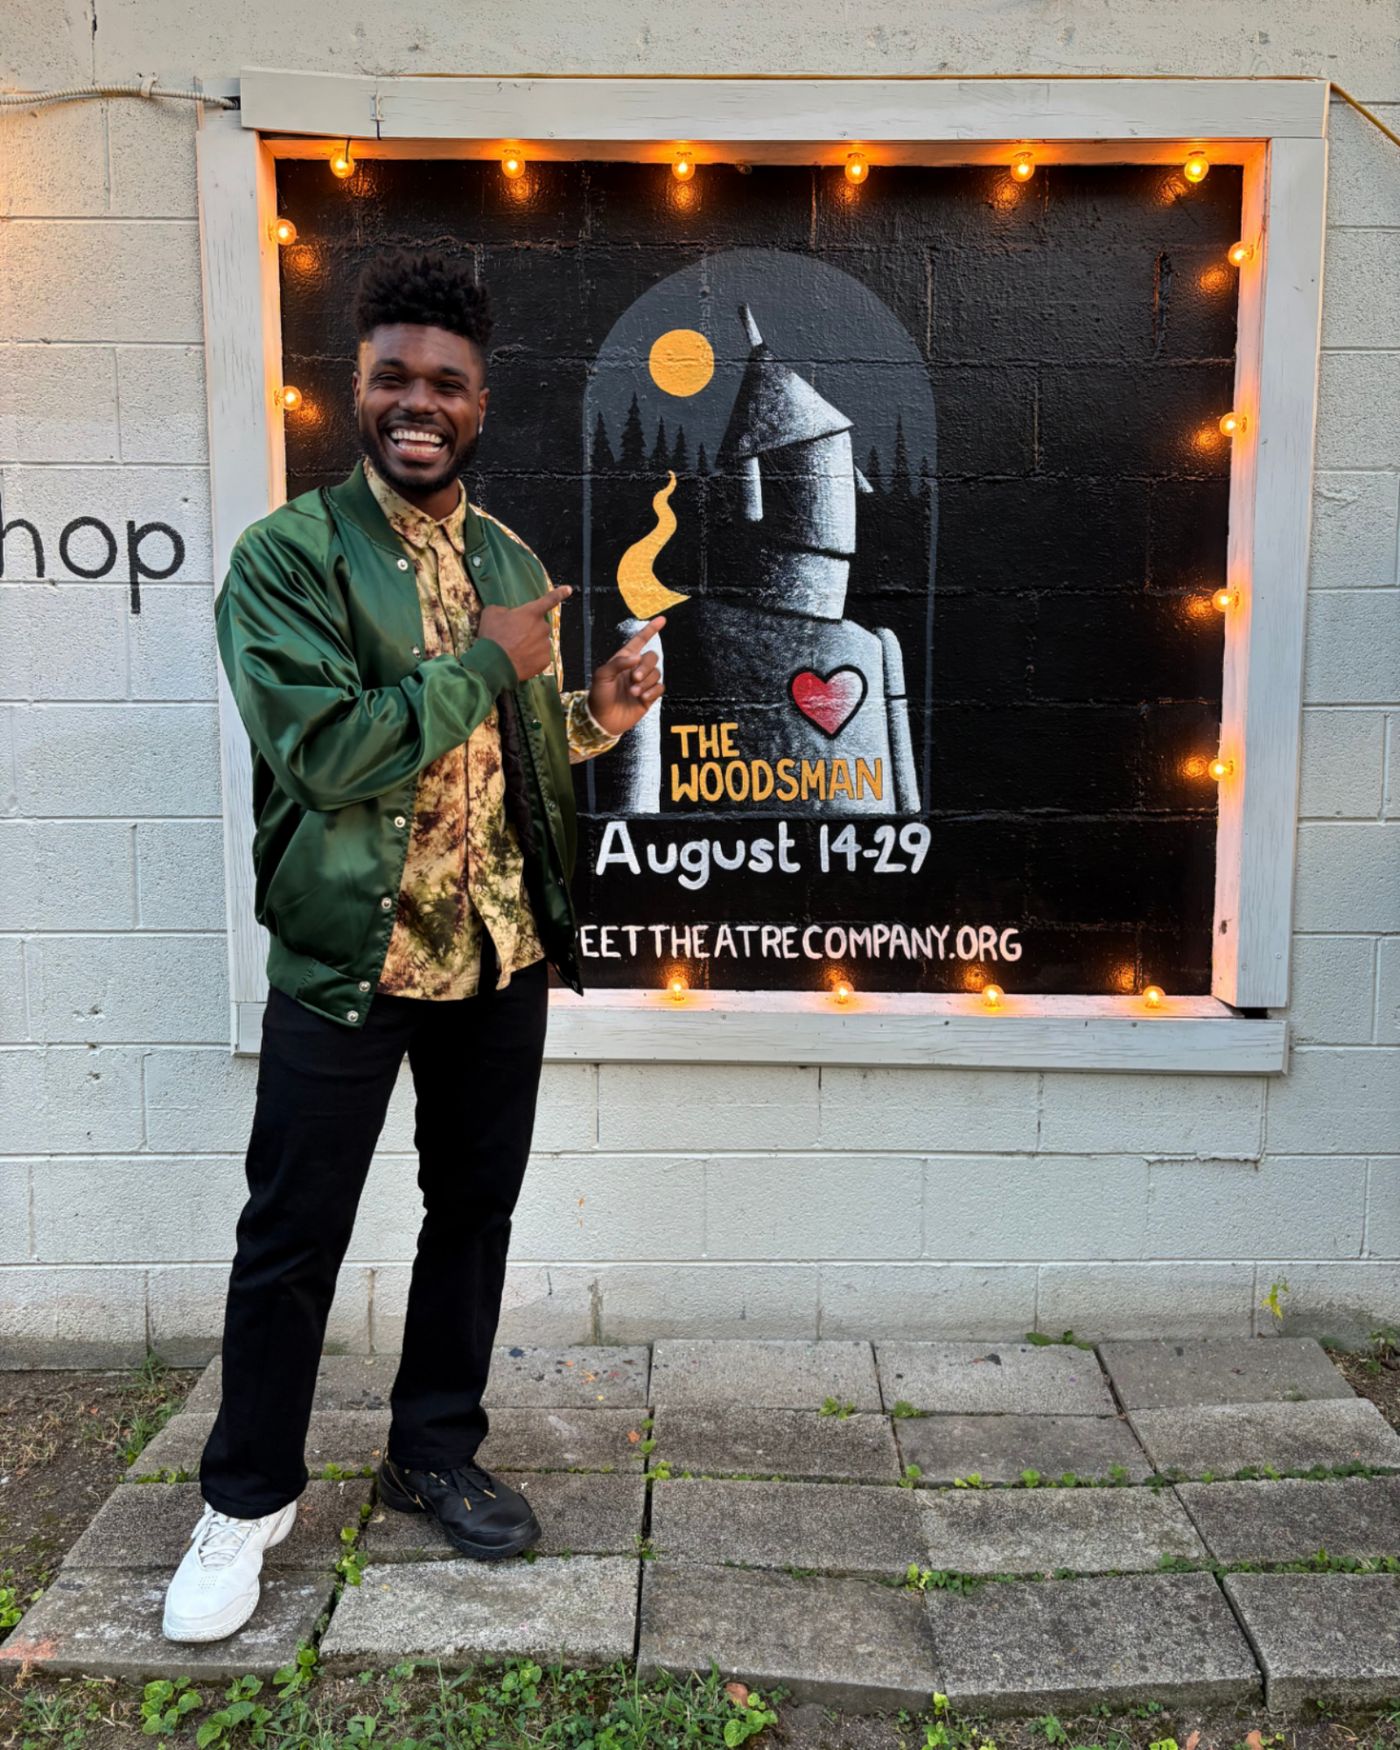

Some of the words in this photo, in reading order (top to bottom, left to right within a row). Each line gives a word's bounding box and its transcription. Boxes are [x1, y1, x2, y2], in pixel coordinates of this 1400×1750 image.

[0, 491, 185, 614] hop
[670, 722, 740, 758] THE
[670, 758, 883, 802] WOODSMAN
[595, 820, 801, 890] August
[819, 822, 931, 873] 14-29
[575, 924, 1023, 961] EETTHEATRECOMPANY.ORG
